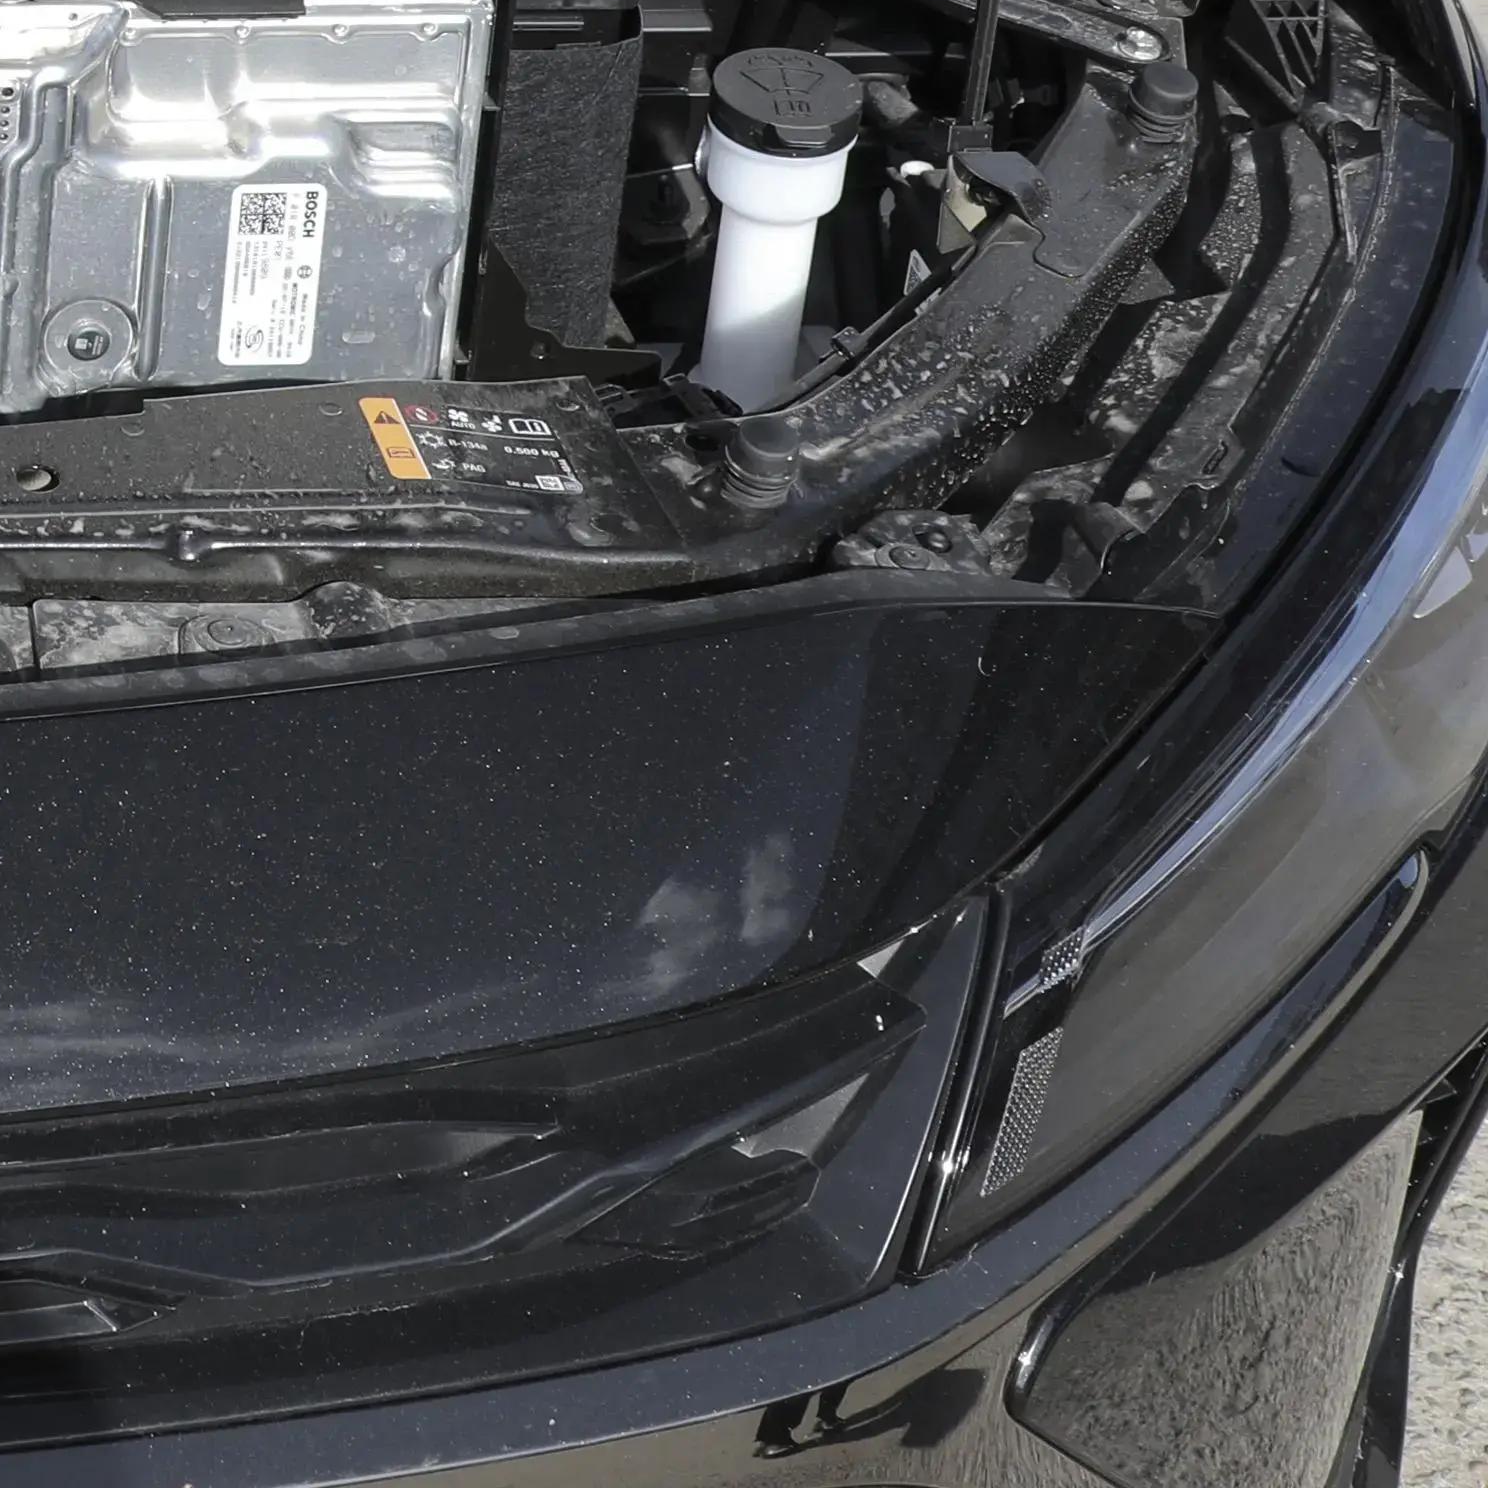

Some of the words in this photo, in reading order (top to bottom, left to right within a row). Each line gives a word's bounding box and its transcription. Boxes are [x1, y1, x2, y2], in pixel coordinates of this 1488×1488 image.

[303, 190, 319, 238] BOSCH
[451, 421, 476, 429] AUTO
[504, 446, 540, 457] 0.500
[462, 462, 487, 473] PAG
